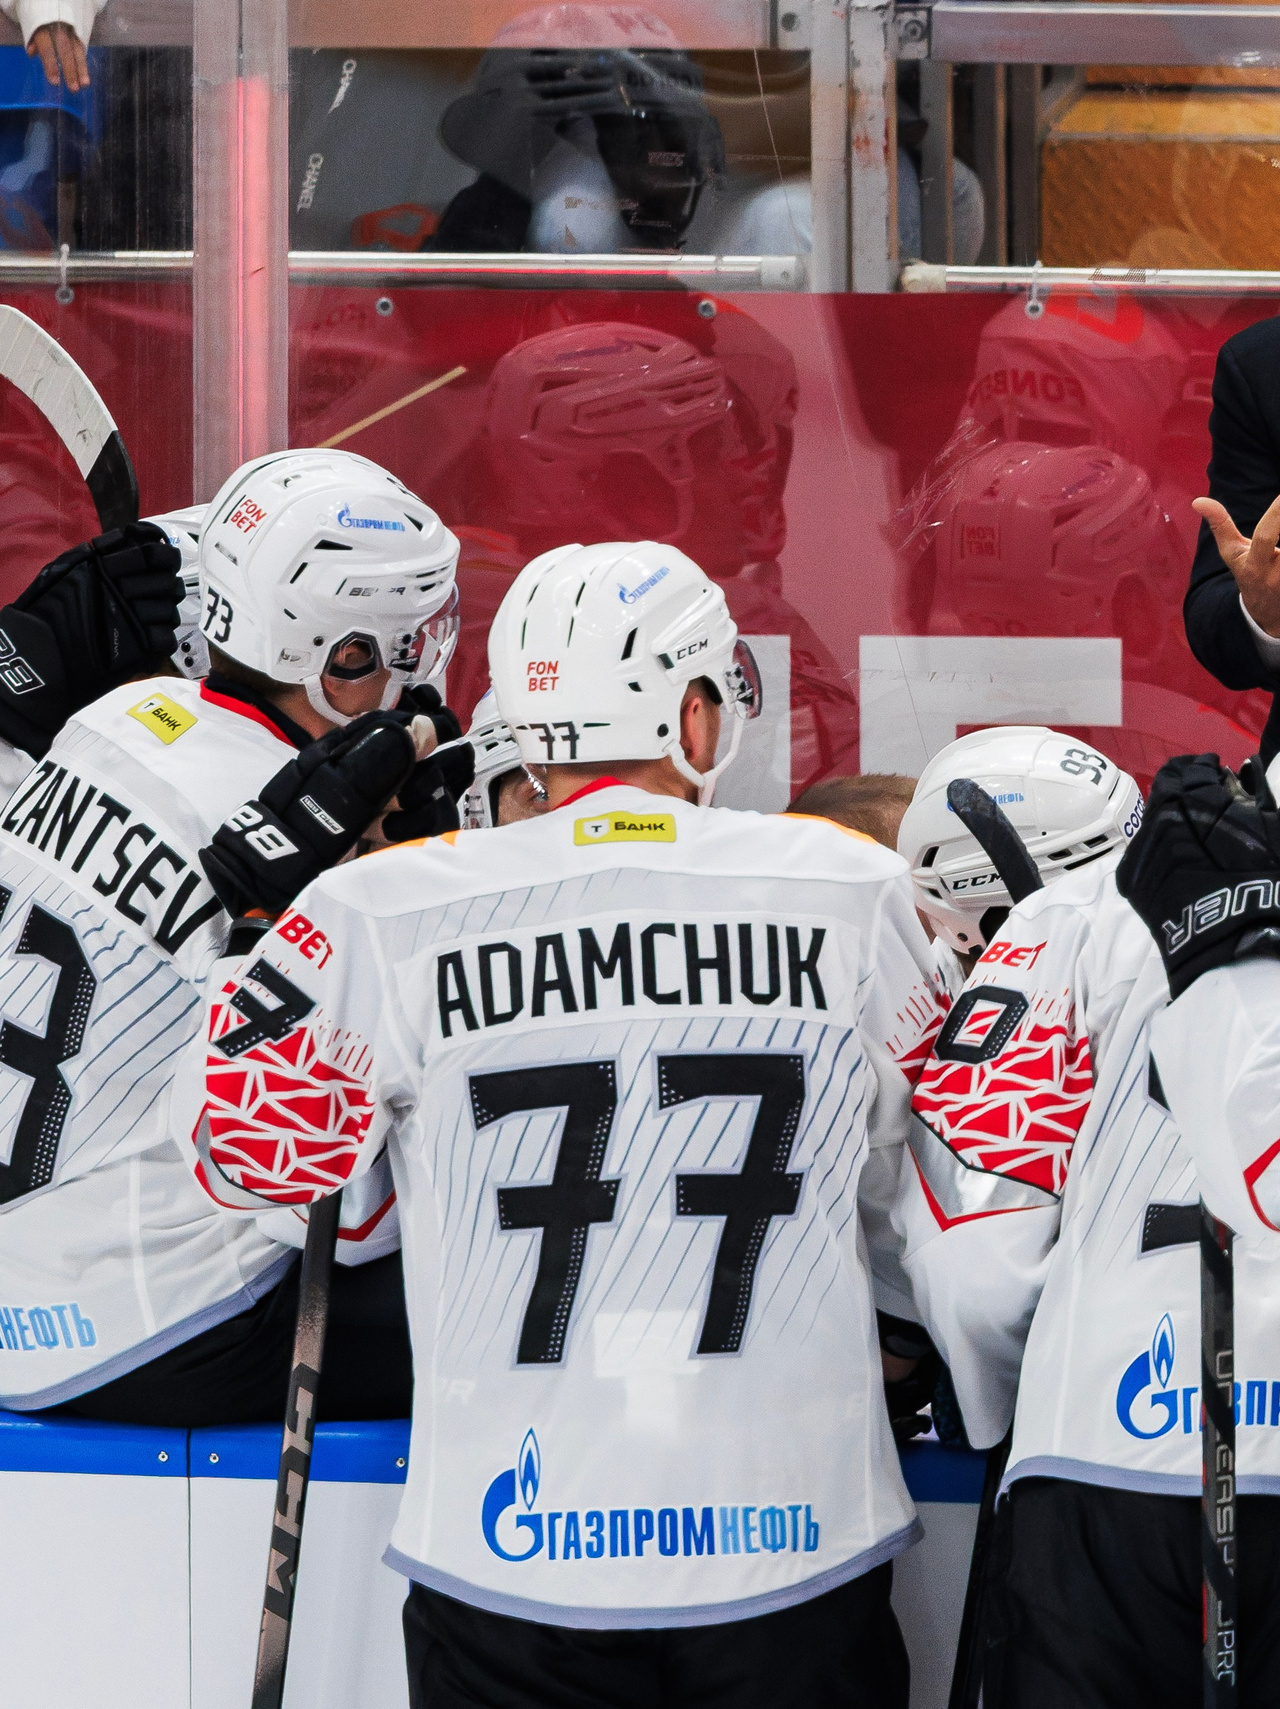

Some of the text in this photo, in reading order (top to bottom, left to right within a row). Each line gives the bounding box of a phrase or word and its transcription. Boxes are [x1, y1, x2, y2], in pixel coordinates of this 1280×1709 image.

[230, 510, 258, 535] BET
[240, 498, 267, 522] FON
[203, 586, 234, 644] 73
[527, 660, 559, 675] FON
[677, 638, 709, 661] CCM
[528, 676, 560, 692] BET
[150, 706, 183, 732] БАНК
[528, 720, 580, 761] 77
[1060, 747, 1108, 786] 93
[613, 820, 666, 833] БАНК
[0, 759, 228, 956] ZANTSEV
[952, 873, 1005, 891] CCM
[436, 921, 830, 1039] ADAMCHUK
[0, 884, 98, 1204] 3
[932, 983, 1030, 1066] 0
[466, 1050, 809, 1367] 77
[546, 1503, 820, 1561] ГАЗПРОМНЕФТЬ
